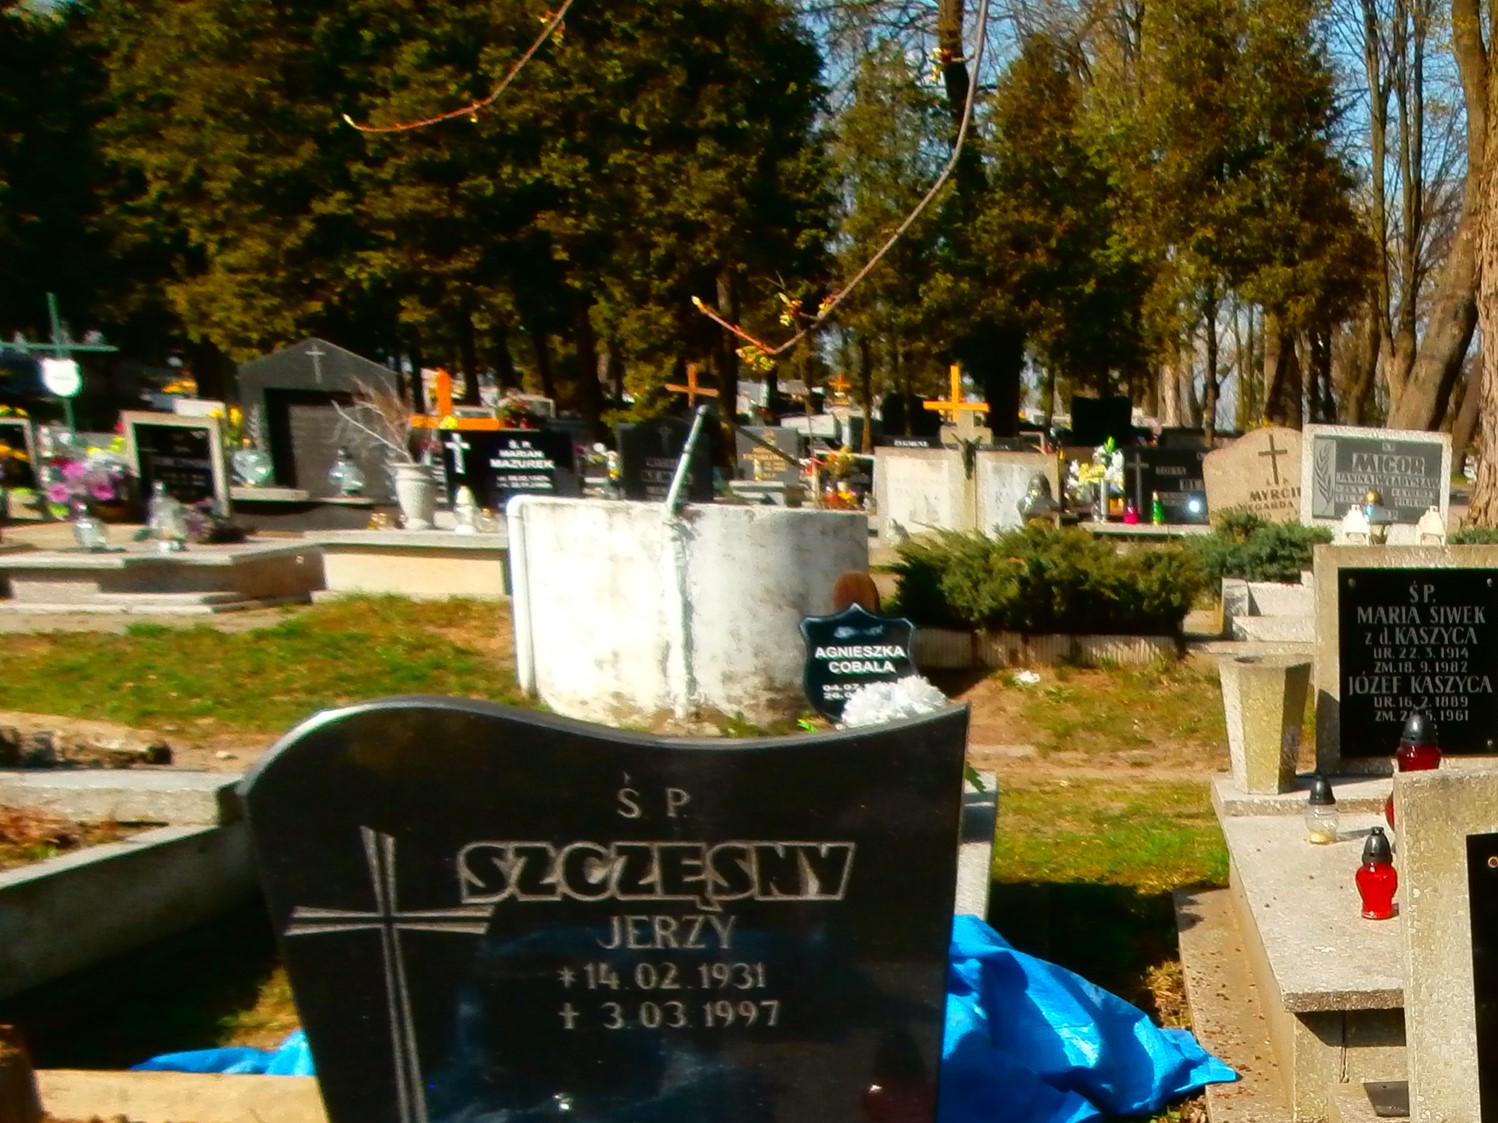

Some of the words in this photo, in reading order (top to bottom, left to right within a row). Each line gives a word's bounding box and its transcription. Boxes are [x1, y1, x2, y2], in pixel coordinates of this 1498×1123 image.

[489, 459, 557, 470] MAZUREK
[1357, 606, 1421, 624] MARIA
[1430, 606, 1486, 624] SIWEK
[815, 645, 907, 659] AGNIESZKA
[828, 661, 897, 674] COBALA
[1348, 671, 1402, 696] JÓZEF
[1411, 676, 1493, 694] KASZYCA
[457, 840, 856, 912] SZCZĘSNY
[597, 914, 737, 950] JERZY
